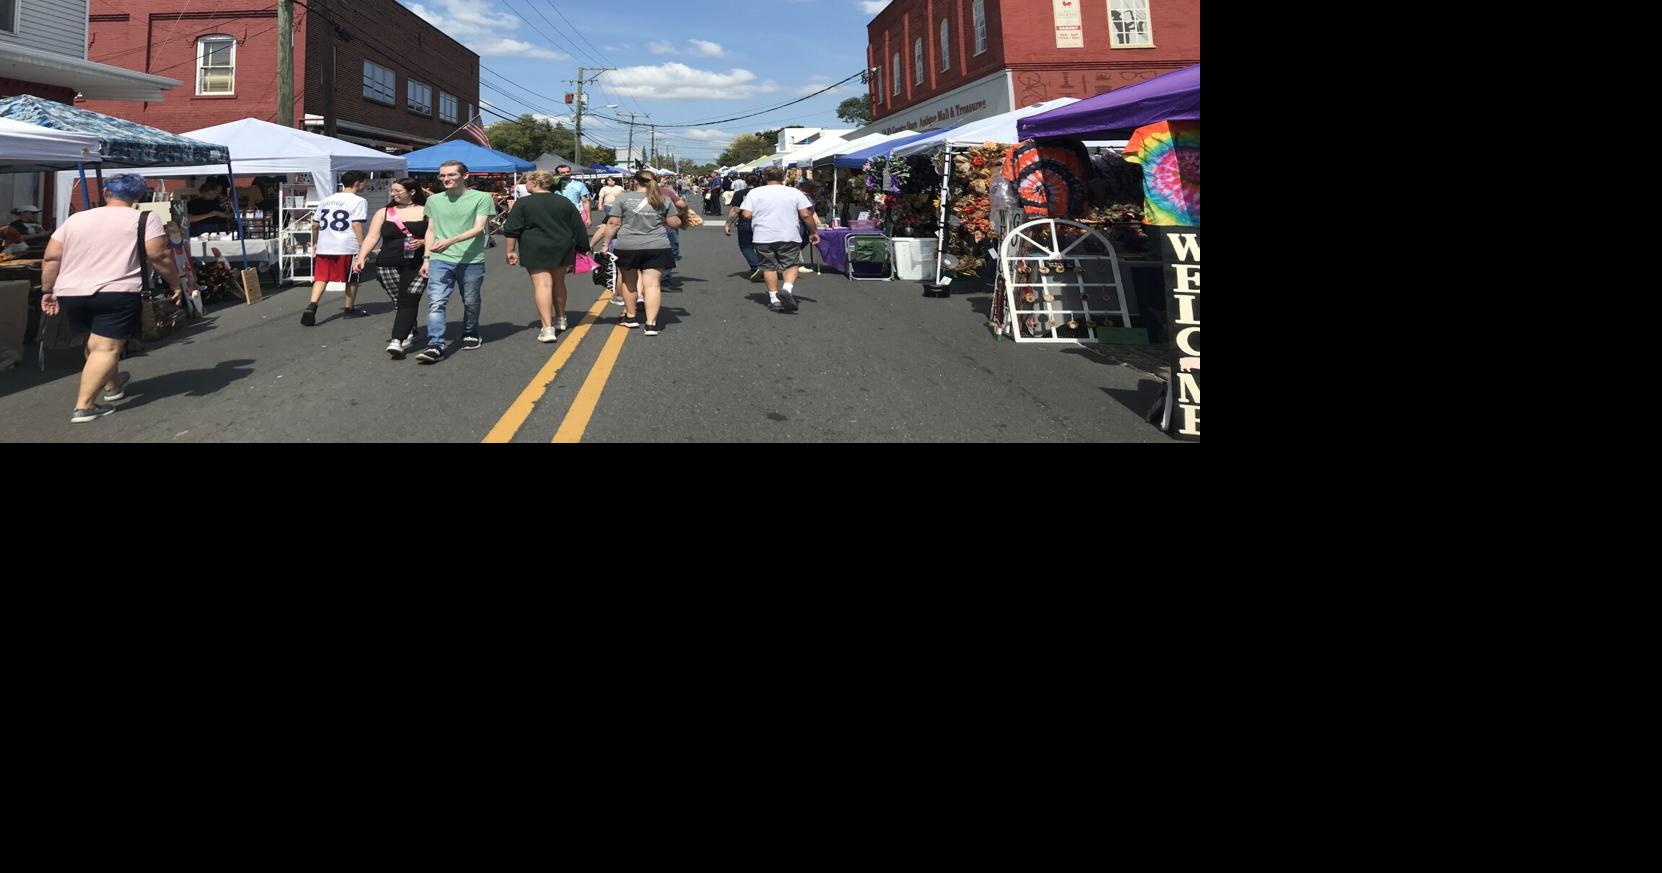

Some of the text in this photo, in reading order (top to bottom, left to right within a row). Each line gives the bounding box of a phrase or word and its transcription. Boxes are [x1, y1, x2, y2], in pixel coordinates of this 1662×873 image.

[937, 109, 950, 121] Mall
[950, 106, 956, 118] &
[955, 99, 986, 116] Treasures
[319, 209, 350, 231] 38
